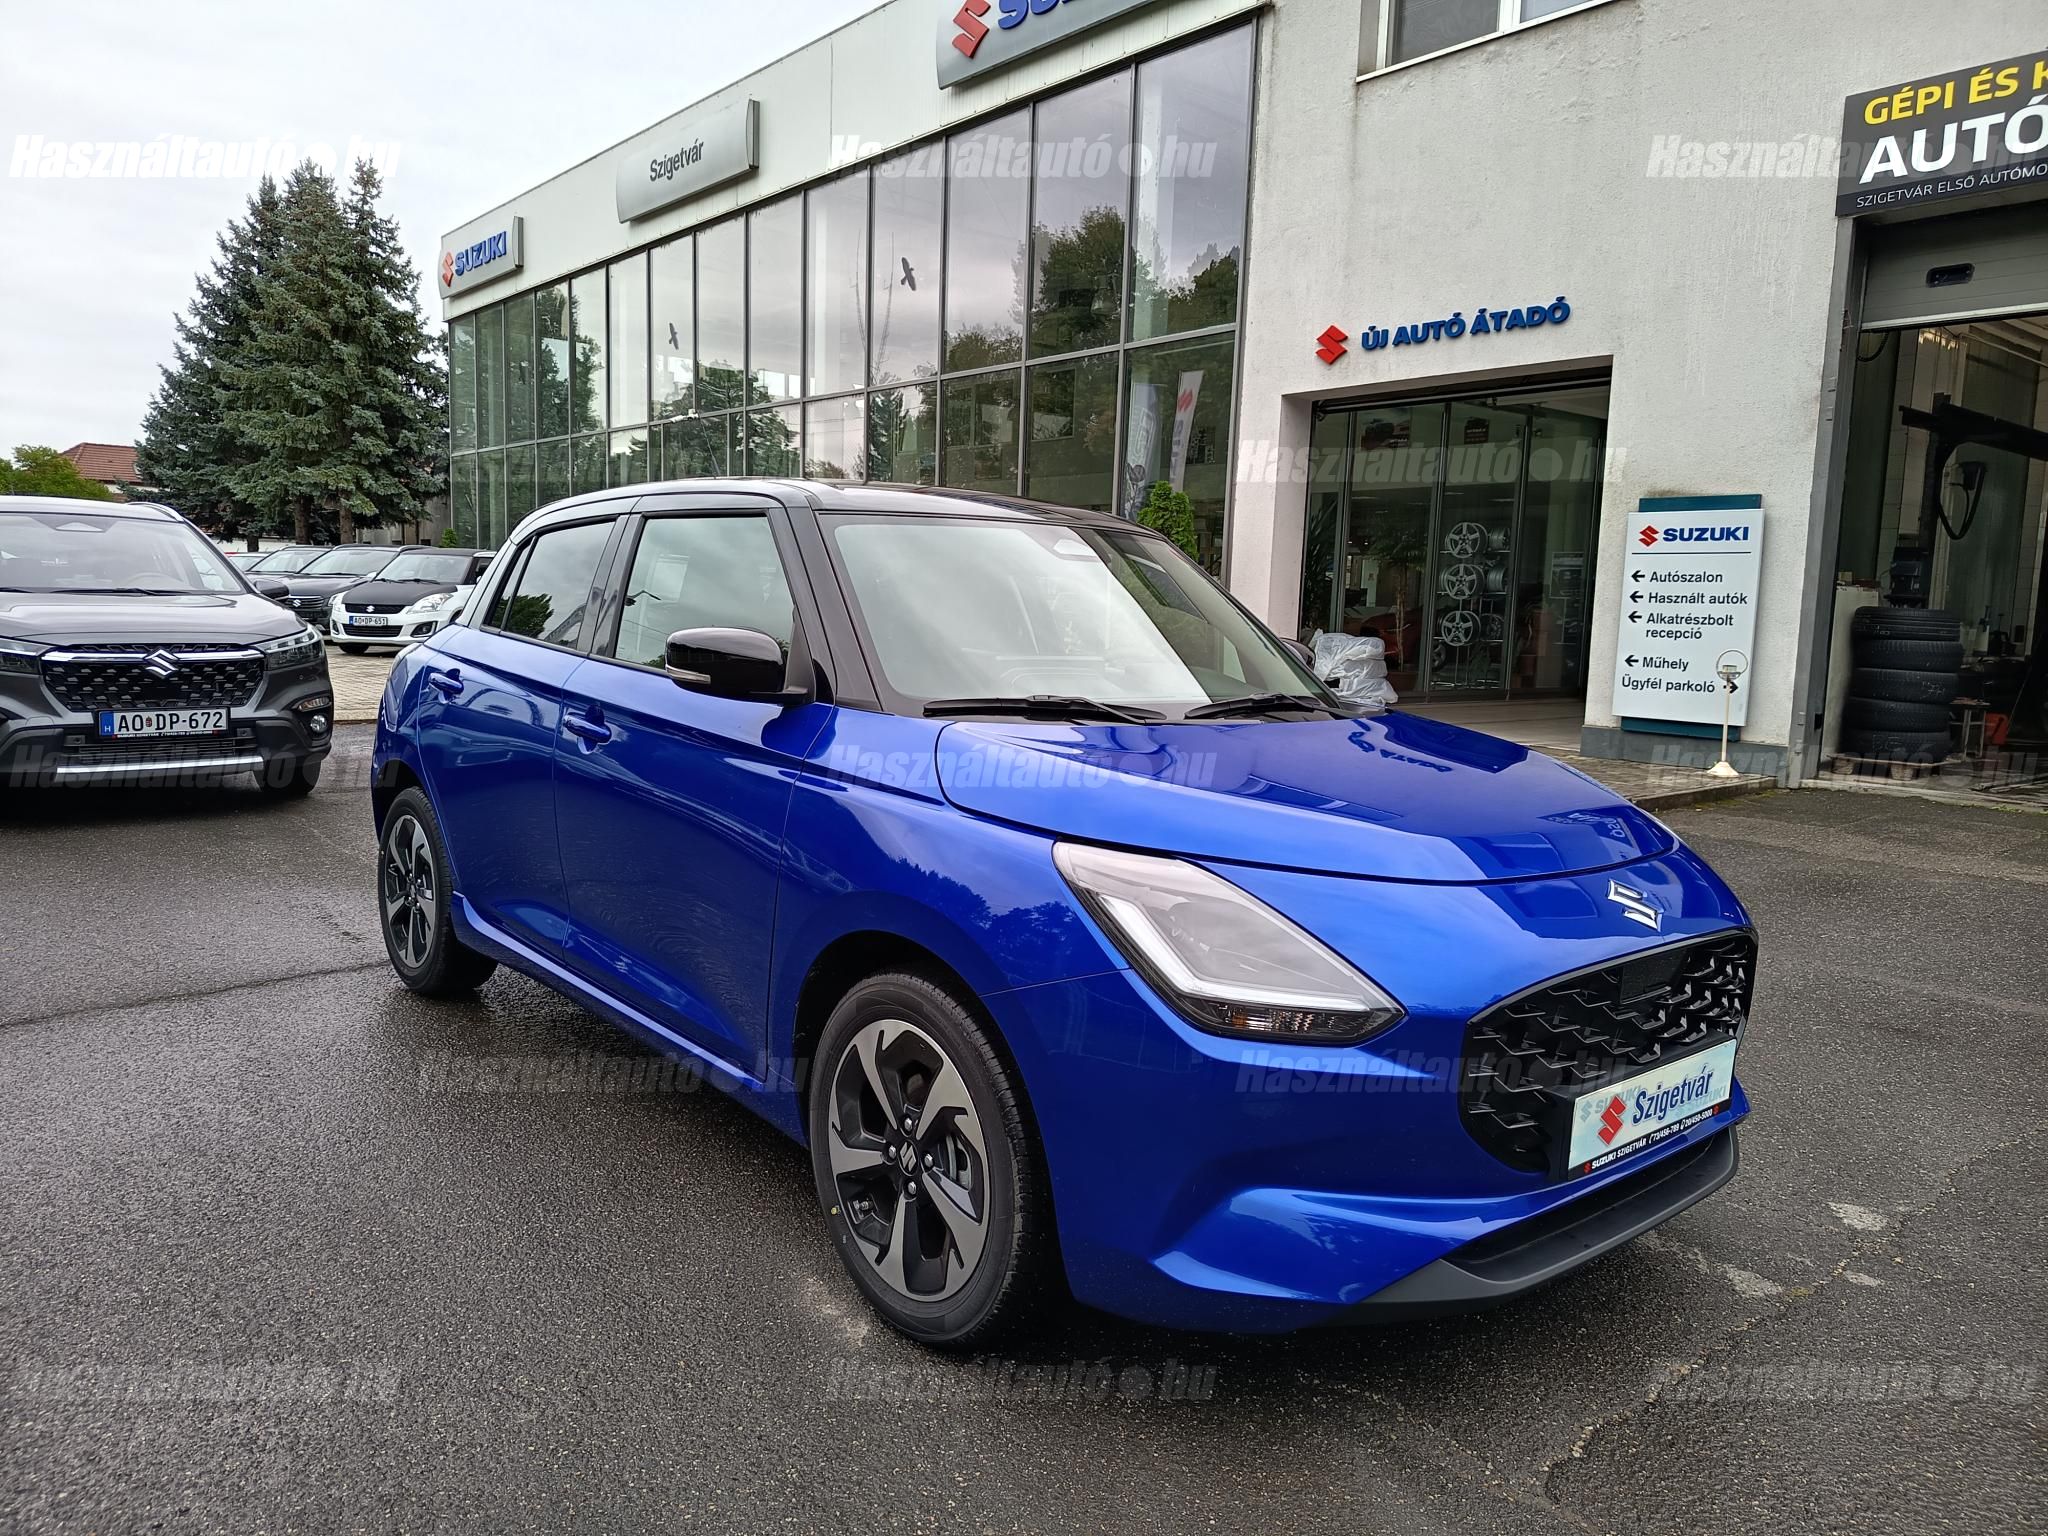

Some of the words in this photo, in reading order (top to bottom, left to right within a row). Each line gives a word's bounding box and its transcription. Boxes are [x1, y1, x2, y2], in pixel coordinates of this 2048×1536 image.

[1864, 81, 1955, 125] GÉPI
[1968, 66, 2020, 104] ÉS
[1859, 94, 2048, 185] AUTÓ
[650, 138, 704, 182] Szigetvár
[1856, 184, 1933, 208] SZIGETVÁR
[1938, 174, 1975, 193] ELSŐ
[1979, 163, 2048, 187] AUTÓMO
[455, 231, 507, 277] SUZUKI
[1361, 325, 1389, 351] ÚJ
[1392, 312, 1466, 347] AUTÓ
[1470, 296, 1571, 336] ÁTADÓ
[1663, 526, 1749, 542] SUZUKI
[1650, 570, 1723, 583] Autószalon
[1648, 592, 1705, 604] Használt
[1709, 592, 1748, 605] autók
[1646, 612, 1734, 626] Alkatrészbolt
[1646, 627, 1702, 641] recepció
[1642, 656, 1689, 672] Műhely
[1622, 673, 1662, 691] Ügyfél
[1666, 679, 1716, 693] parkoló
[1632, 1065, 1713, 1124] Szigetvár
[1591, 1152, 1616, 1169] SUZUKI
[1617, 1137, 1647, 1159] SZIGETVÁR
